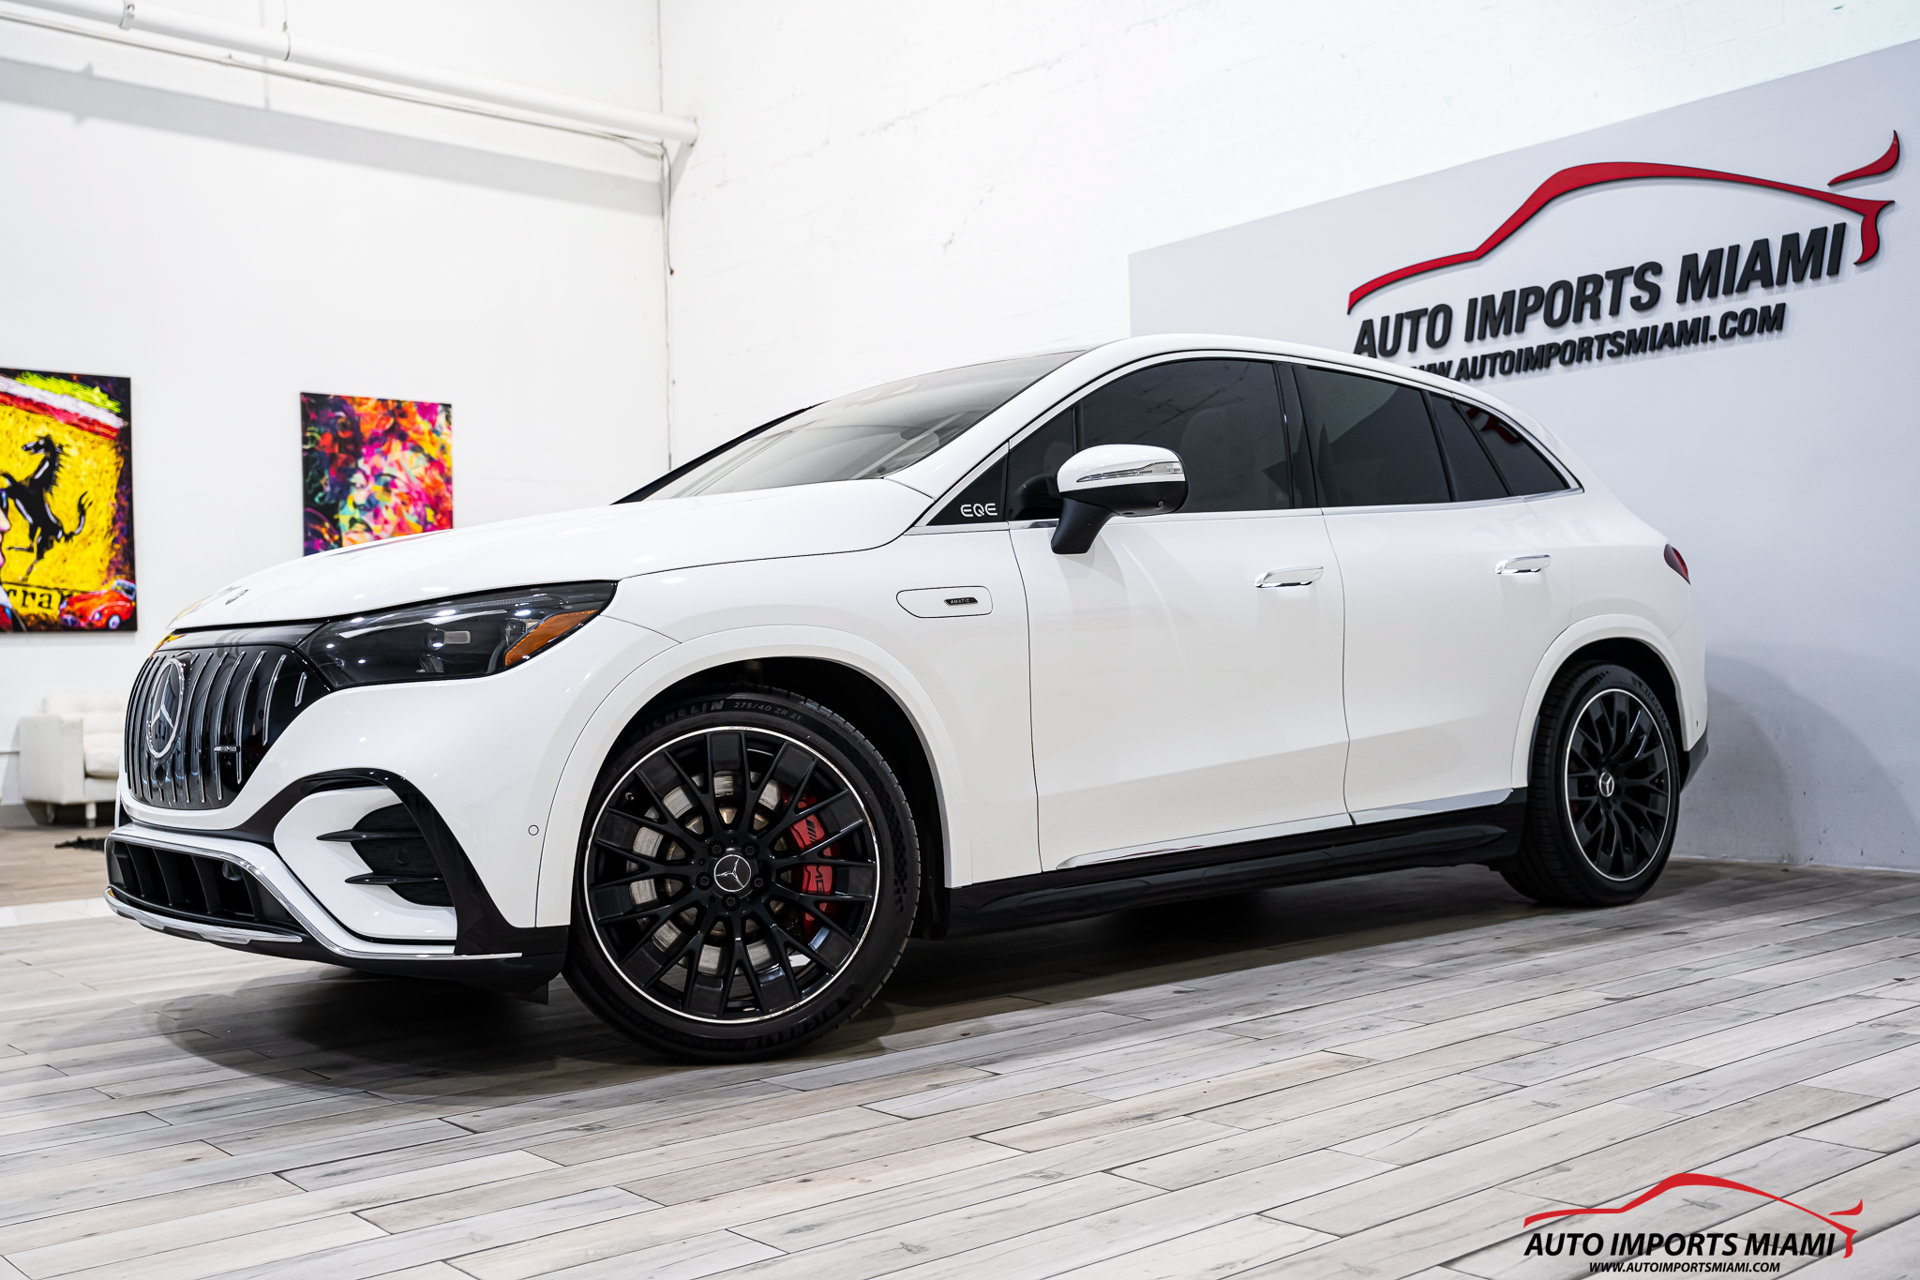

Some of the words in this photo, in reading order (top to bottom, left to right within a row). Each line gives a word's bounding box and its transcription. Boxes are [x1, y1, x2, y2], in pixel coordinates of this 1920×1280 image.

[1353, 303, 1453, 358] AUTO
[1464, 262, 1663, 343] IMPORTS
[1676, 222, 1847, 304] MIAMI
[1411, 302, 1787, 382] WAUTOIMPORTSMIAMI.COM
[960, 502, 998, 518] EQE
[733, 701, 772, 712] 275/40
